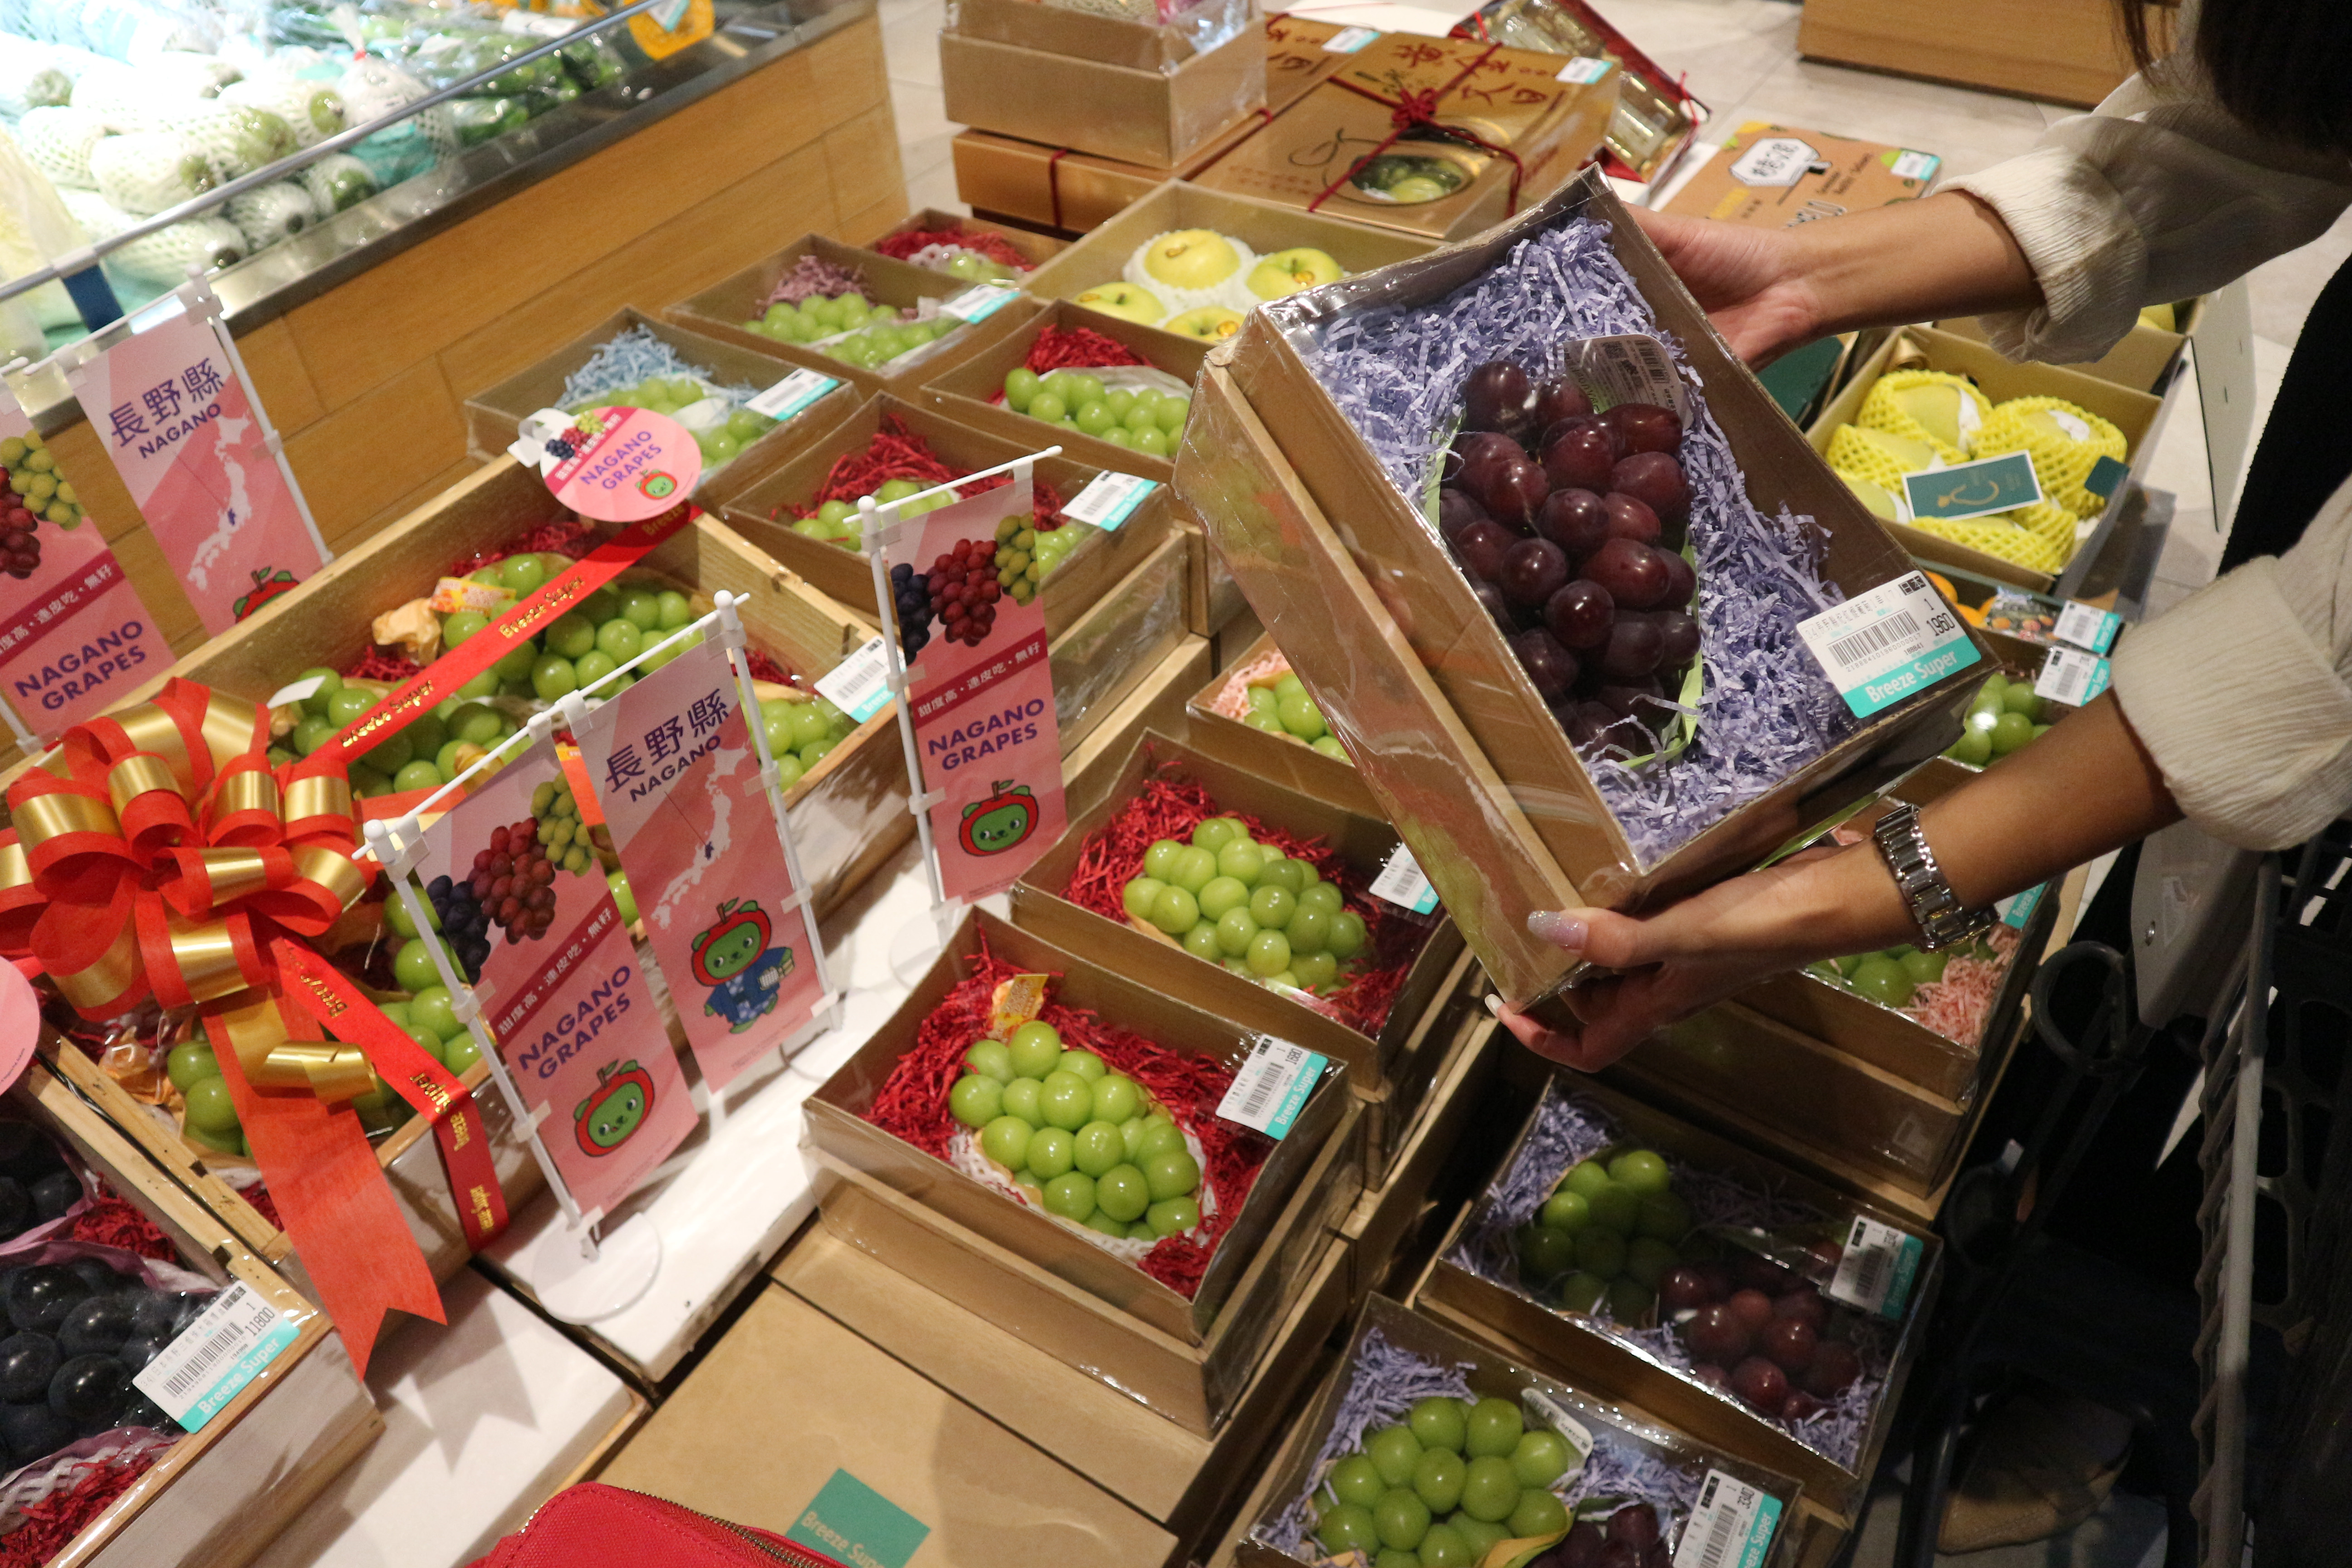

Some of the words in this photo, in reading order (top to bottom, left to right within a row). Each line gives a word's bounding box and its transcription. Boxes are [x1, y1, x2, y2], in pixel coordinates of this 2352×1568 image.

[109, 358, 224, 447] 長野縣
[139, 403, 222, 459] NAGANO
[579, 430, 652, 485] NAGANO
[602, 444, 662, 490] GRAPES
[1901, 575, 1926, 595] 日本
[1924, 598, 1934, 611] 1
[1926, 612, 1955, 637] 1960
[15, 622, 142, 696] NAGANO
[42, 646, 146, 710] GRAPES
[1865, 671, 1916, 703] Breeze
[1914, 651, 1958, 680] Super
[389, 680, 434, 714] Super
[605, 688, 730, 793] 長野縣
[928, 698, 1045, 756] NAGANO
[942, 723, 1038, 771] GRAPES
[629, 735, 723, 803] NAGANO
[517, 965, 631, 1071] NAGANO
[537, 992, 631, 1079] GRAPES
[1274, 1094, 1301, 1125] Breeze
[1294, 1066, 1316, 1094] Super
[245, 1307, 275, 1337] 11800
[246, 1302, 256, 1311] 1
[197, 1372, 244, 1414] Breeze
[240, 1337, 280, 1374] Super
[801, 1511, 849, 1552] Breeze
[1750, 1512, 1772, 1547] Super
